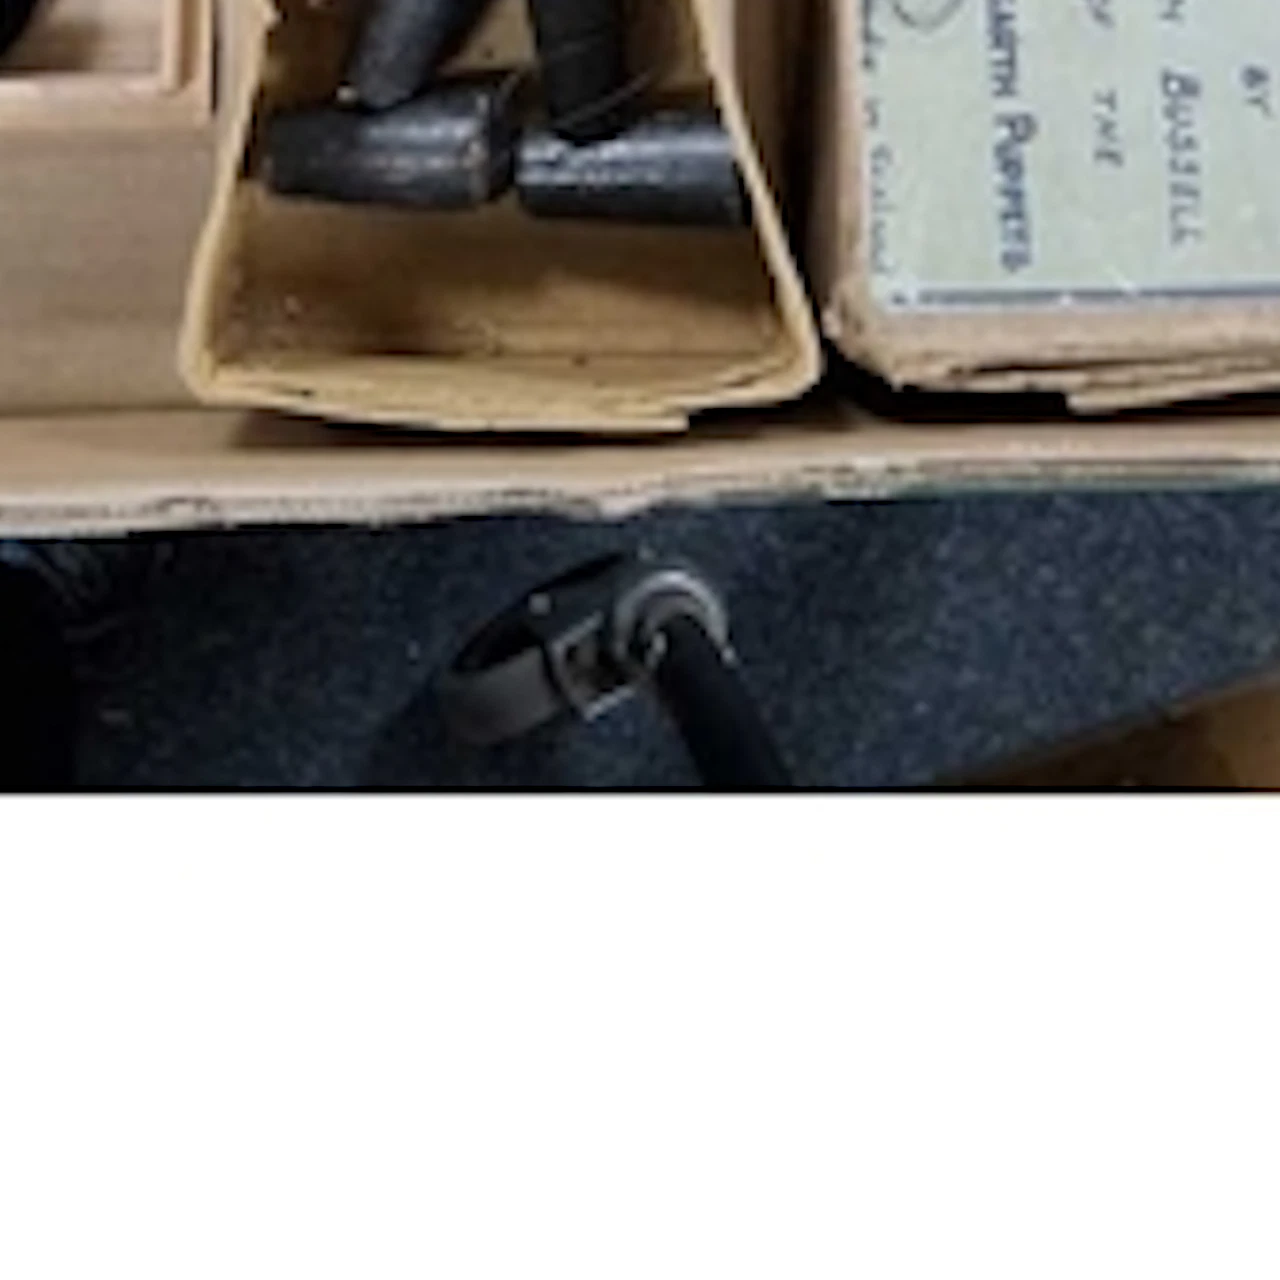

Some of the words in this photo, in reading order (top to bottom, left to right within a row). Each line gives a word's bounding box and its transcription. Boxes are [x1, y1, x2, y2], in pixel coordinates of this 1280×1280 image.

[1089, 88, 1125, 170] THE
[1240, 64, 1274, 120] BY
[992, 111, 1038, 275] PUPPETS
